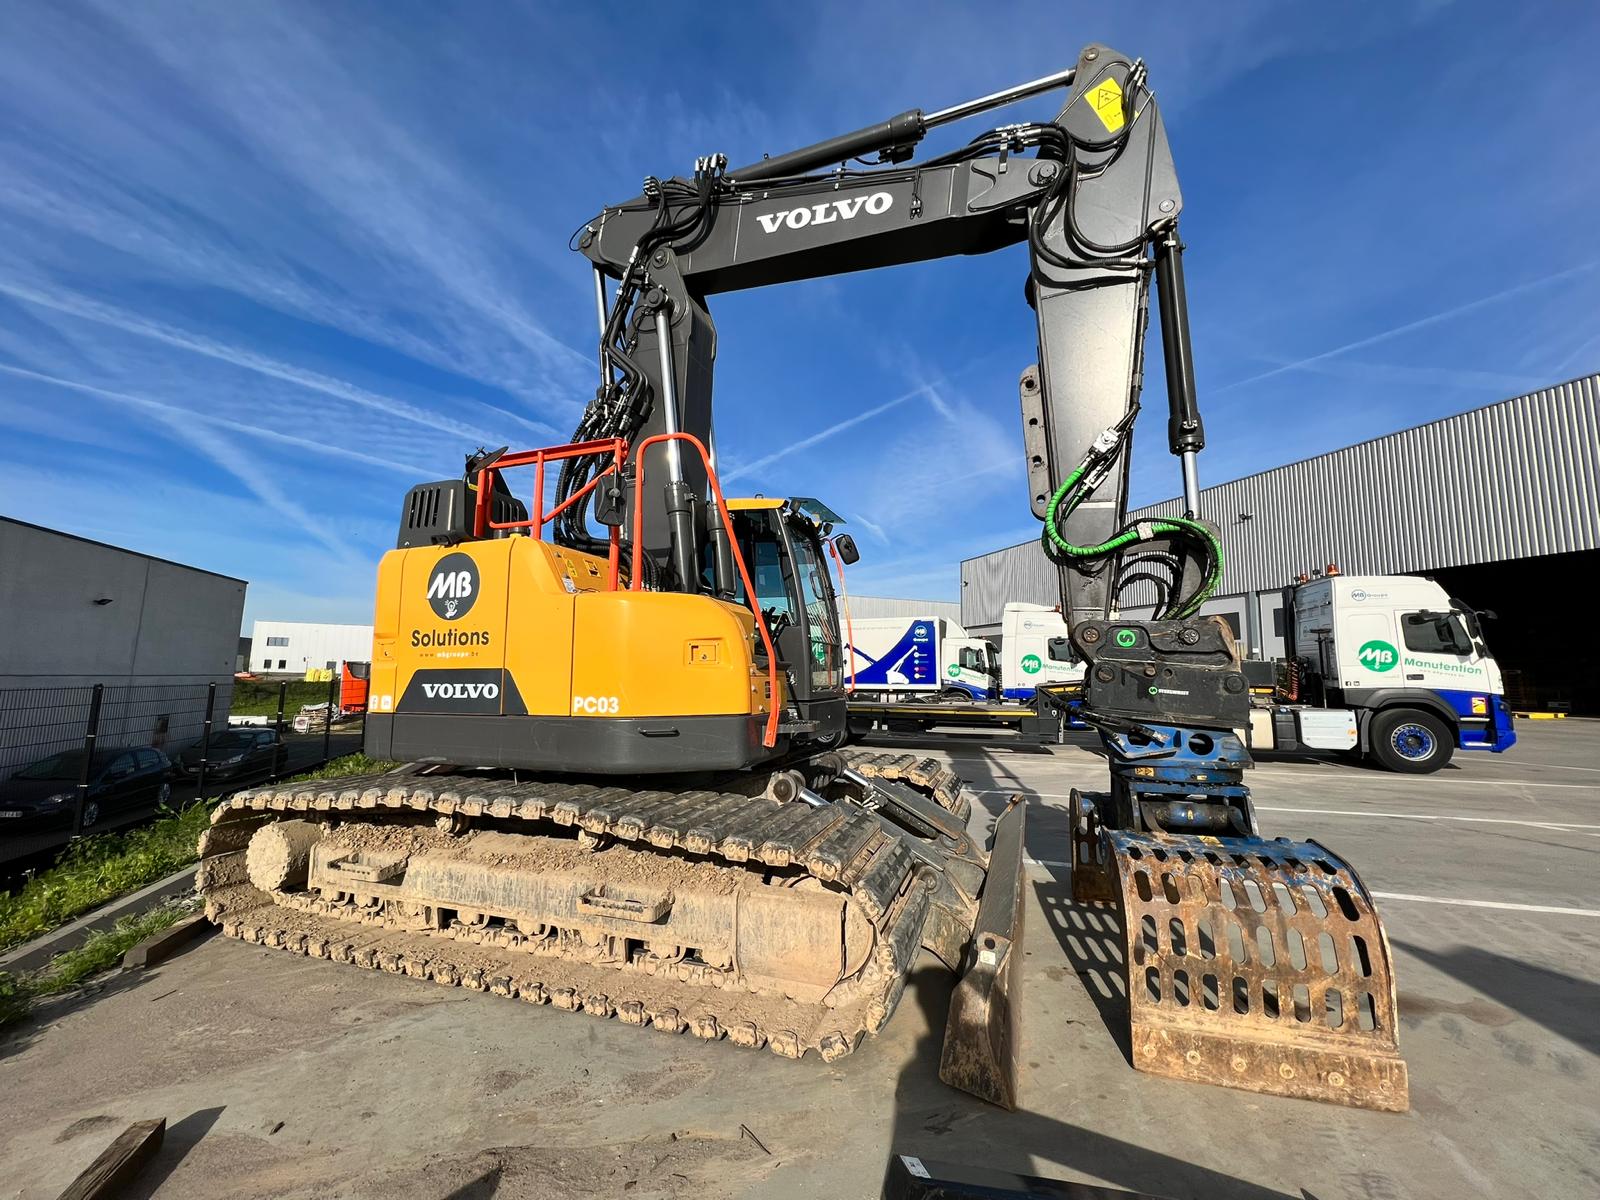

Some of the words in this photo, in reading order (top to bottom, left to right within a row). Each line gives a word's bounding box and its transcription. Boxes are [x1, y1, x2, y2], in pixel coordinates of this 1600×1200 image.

[756, 192, 894, 234] VOLVO
[426, 570, 472, 599] MB
[411, 628, 490, 647] Solutions
[1020, 658, 1039, 670] MB
[1358, 648, 1393, 666] MB
[1404, 657, 1482, 675] Manutention
[422, 683, 499, 699] VOLVO
[573, 696, 619, 713] PC03
